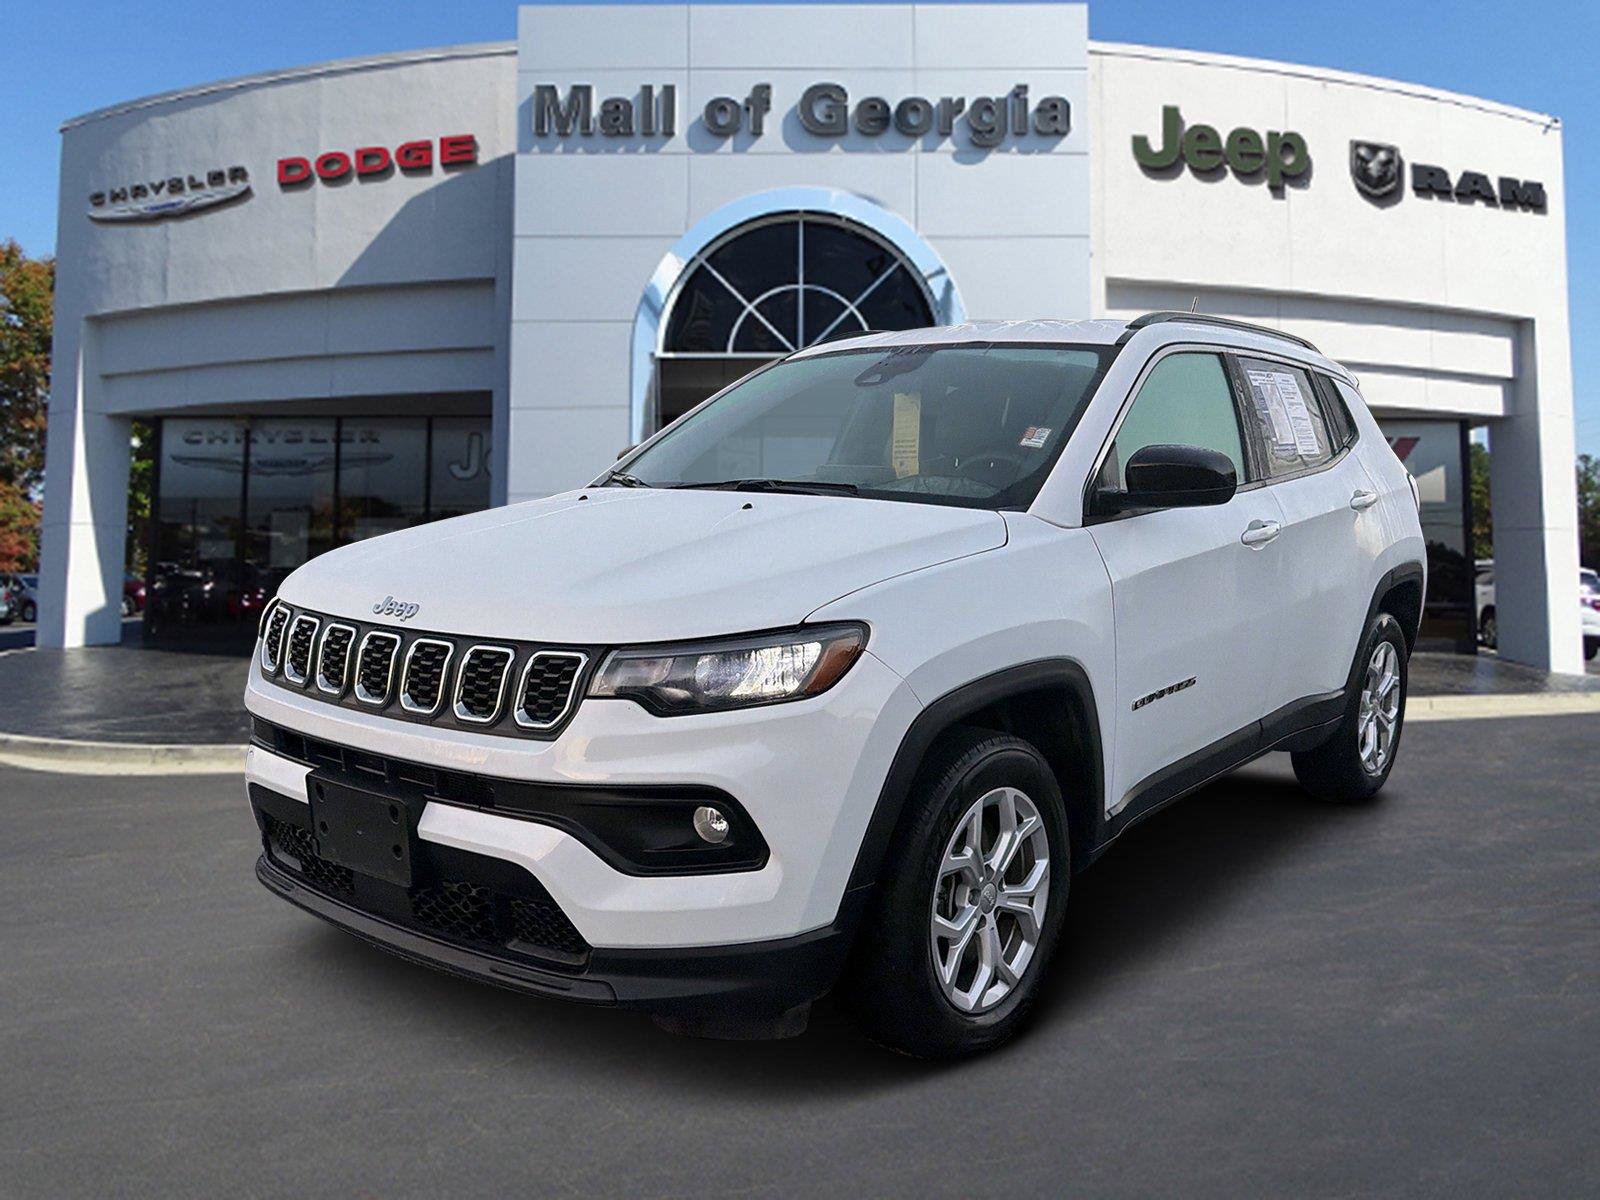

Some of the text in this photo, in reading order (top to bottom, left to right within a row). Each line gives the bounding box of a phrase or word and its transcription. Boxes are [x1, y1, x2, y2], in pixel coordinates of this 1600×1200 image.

[533, 83, 1072, 148] Mall of Georgia
[277, 134, 476, 187] DODGE
[1132, 105, 1309, 194] Jeep
[89, 166, 249, 206] CHRYSLER
[1411, 163, 1548, 214] RAM
[373, 595, 420, 622] Jeep
